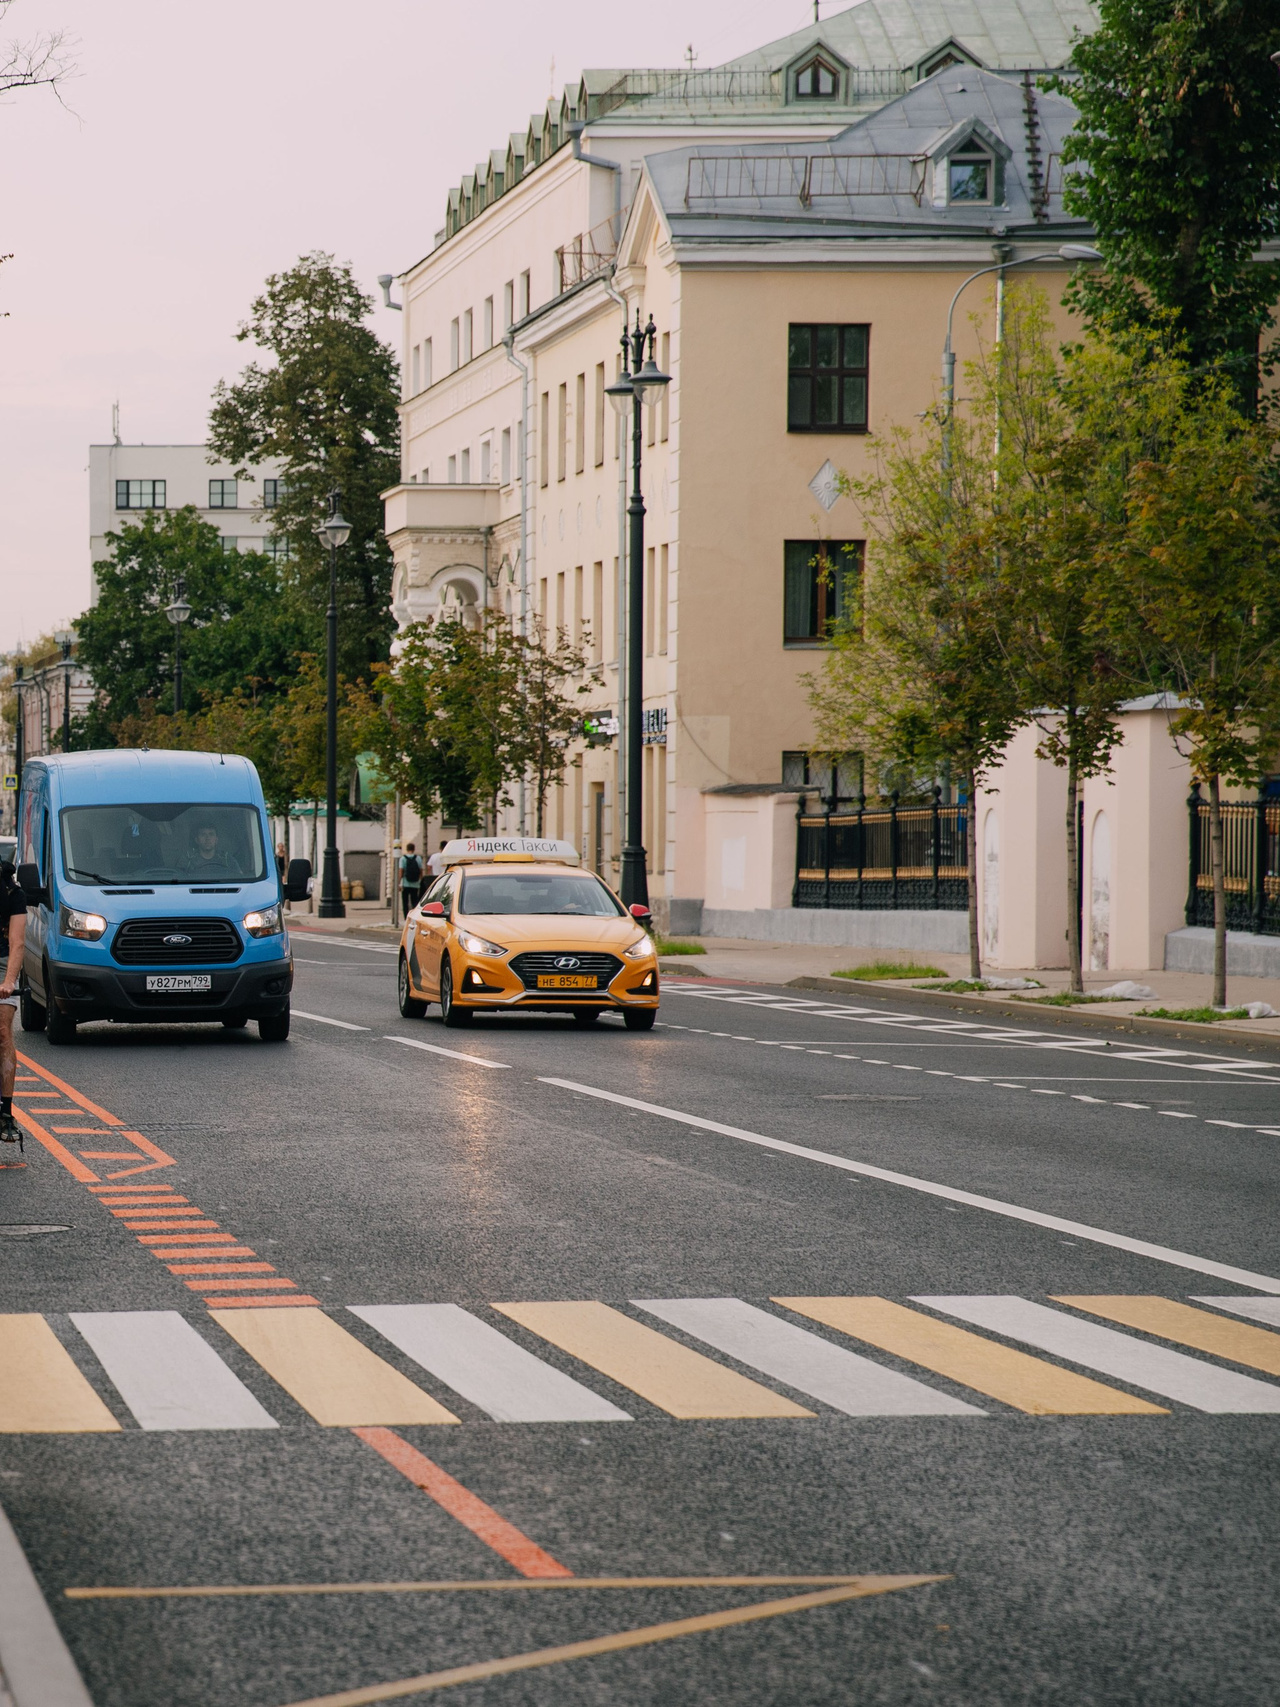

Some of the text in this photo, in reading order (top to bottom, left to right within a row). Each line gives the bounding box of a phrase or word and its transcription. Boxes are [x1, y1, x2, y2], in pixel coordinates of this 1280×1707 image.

[467, 839, 558, 853] Яндекс Такси
[192, 976, 208, 985] 799
[559, 976, 579, 987] 854
[584, 976, 594, 984] 77
